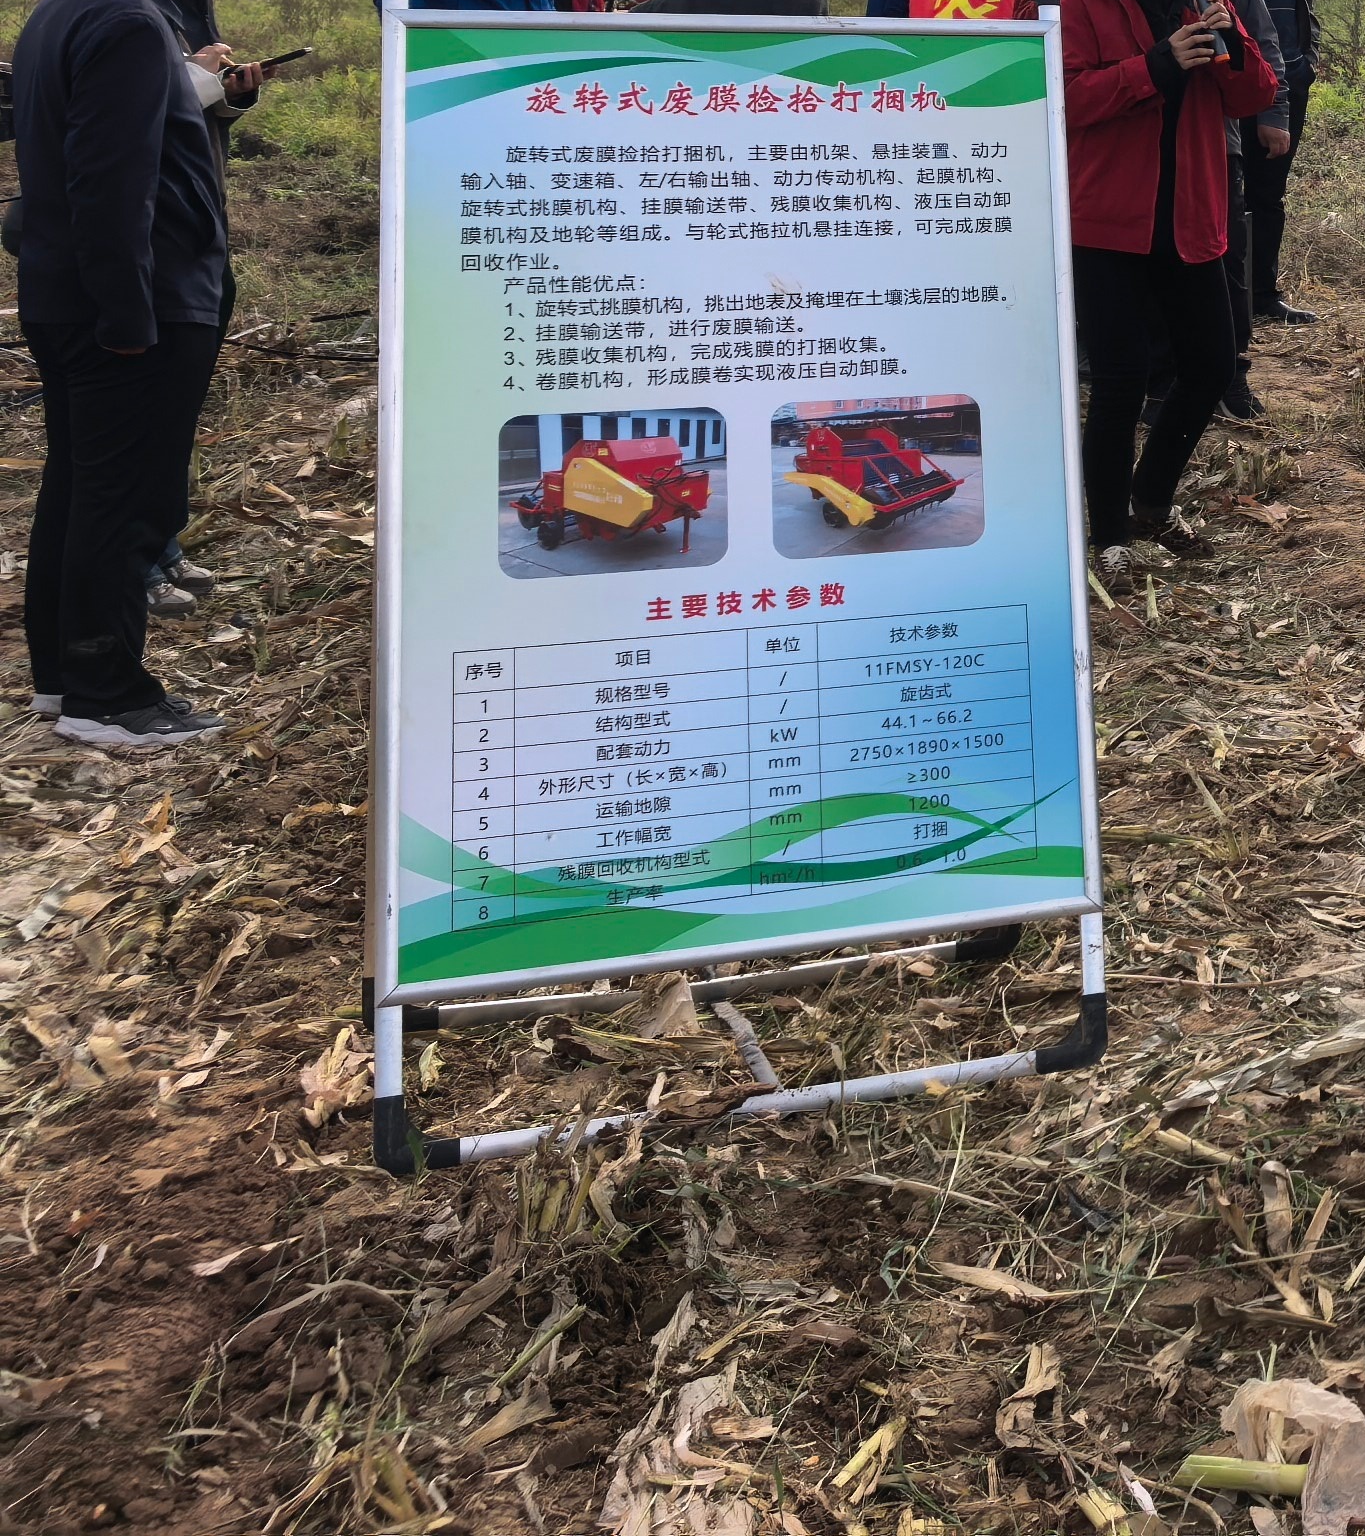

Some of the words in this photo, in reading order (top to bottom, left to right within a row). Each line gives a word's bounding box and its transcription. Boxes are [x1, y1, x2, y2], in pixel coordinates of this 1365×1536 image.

[526, 81, 946, 115] 旋转式废膜捡拾打捆机
[506, 142, 1008, 163] 旋转式废膜捡拾打捆机，主要由机架、悬挂装置、动力
[461, 167, 1004, 190] 输入轴、变速箱、左/右输出轴、动力传动机构、起膜机构、
[461, 192, 1011, 217] 旋转式挑膜机构、挂膜输送带、残膜收集机构、液压自动卸
[461, 217, 1013, 244] 膜机构及地轮等组成。与轮式拖拉机悬挂连接，可完成废膜
[461, 253, 561, 272] 回收作业。
[503, 275, 646, 294] 产品性能优点：
[504, 286, 1008, 318] 1、旋转式挑膜机构，挑出地表及掩埋在土壤浅层的地膜。
[503, 317, 804, 342] 2、挂膜输送带，进行废膜输送。
[504, 336, 886, 367] 3、残膜收集机构，完成残膜的打捆收集。
[503, 358, 907, 391] 4、卷膜机构，形成膜卷实现液压自动卸膜。
[645, 583, 846, 621] 主要技术参数
[465, 662, 503, 681] 序号
[615, 649, 652, 667] 项目
[764, 636, 800, 654] 单位
[889, 623, 959, 644] 技术参数
[480, 700, 488, 714] 1
[595, 682, 670, 704] 规格型号
[779, 671, 787, 686] /
[864, 653, 985, 678] 11FMSY-120C
[479, 728, 489, 743] 2
[595, 710, 671, 733] 结构型式
[779, 699, 788, 715] /
[900, 683, 952, 703] 旋齿式
[479, 757, 489, 772] 3
[596, 739, 671, 761] 配套动力
[770, 727, 798, 743] kW
[478, 787, 490, 801] 4
[768, 755, 801, 769] mm
[850, 733, 1004, 762] 2750×1890×1500
[479, 816, 489, 831] 5
[595, 797, 671, 820] 运输地隙
[769, 783, 802, 797] mm
[907, 766, 951, 783] ≥300
[478, 846, 489, 860] 6
[596, 826, 671, 848] 工作幅宽
[770, 812, 802, 825] mm
[910, 794, 950, 811] 1200
[479, 876, 489, 890] 7
[558, 850, 710, 881] 残膜回收机构型式
[914, 821, 948, 839] 打捆
[479, 905, 489, 920] 8
[607, 885, 663, 905] 生产率
